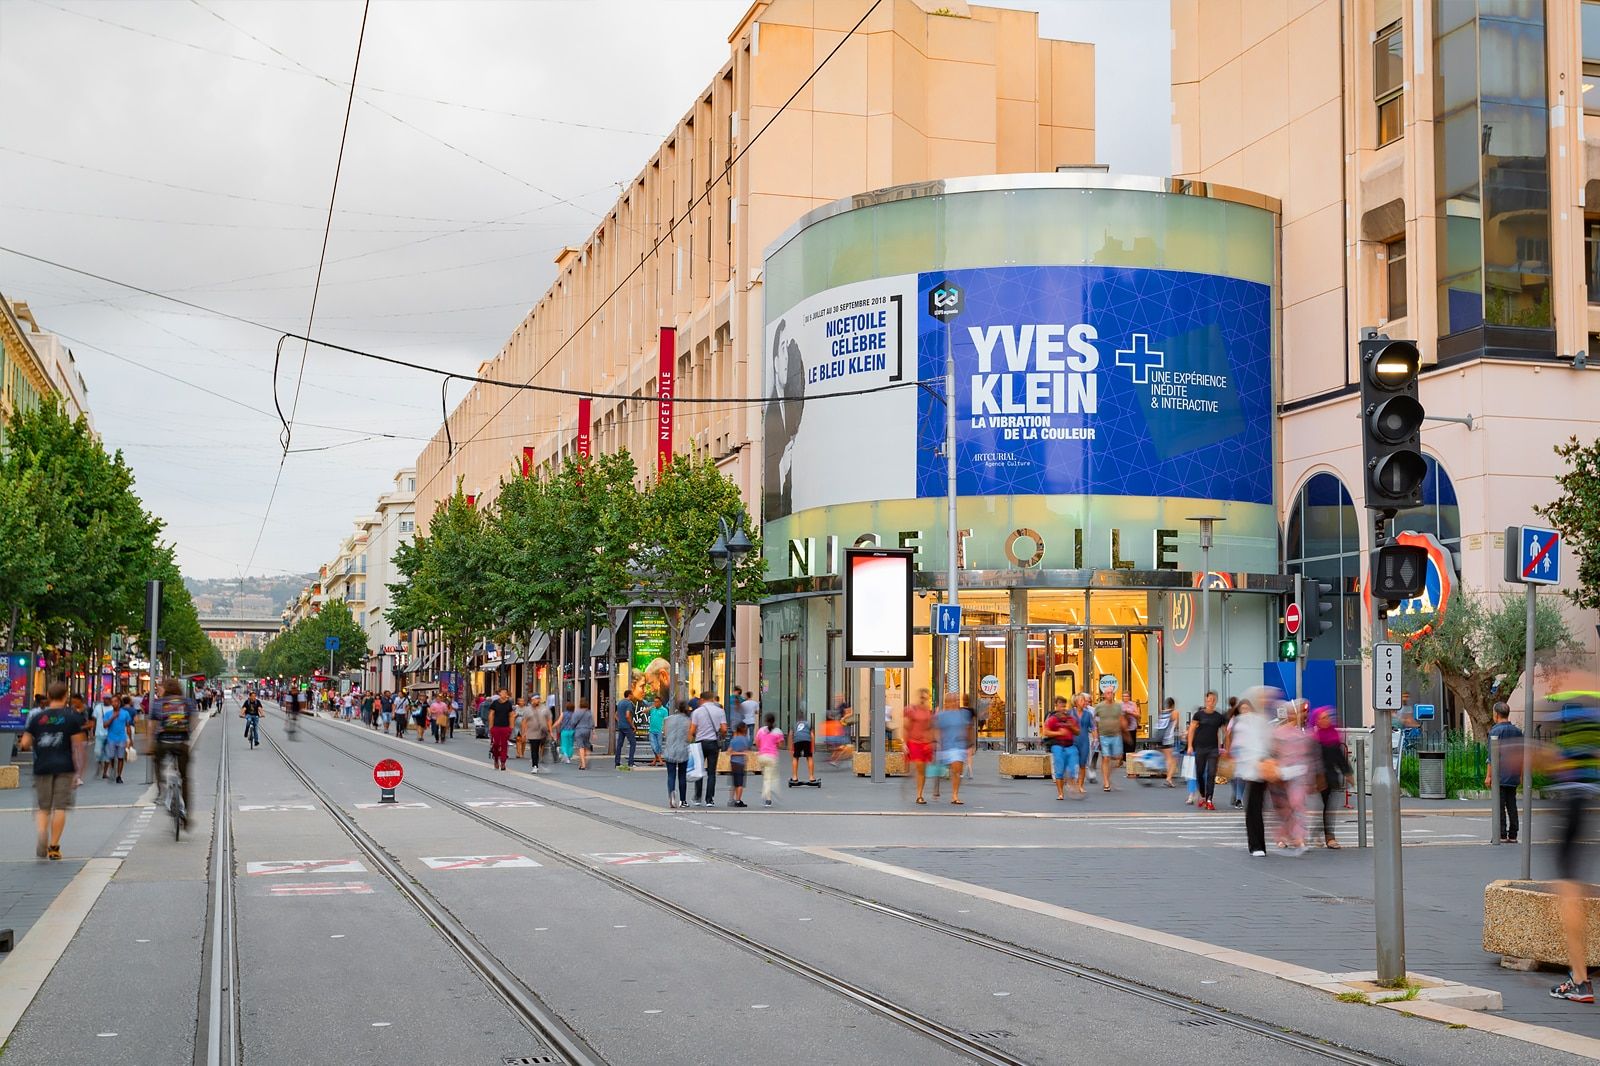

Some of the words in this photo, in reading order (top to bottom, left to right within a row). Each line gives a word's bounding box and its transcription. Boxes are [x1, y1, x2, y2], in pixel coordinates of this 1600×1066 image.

[812, 309, 826, 320] JUILLET
[826, 306, 832, 315] AU
[839, 299, 870, 311] SEPTEMBRE
[871, 296, 887, 305] 2018
[826, 311, 886, 338] NICETOILE
[832, 332, 886, 357] CÉLÈBRE
[968, 324, 1099, 373] YVES
[808, 367, 817, 384] LE
[820, 360, 845, 381] BLEU
[848, 353, 886, 374] KLEIN
[1151, 371, 1171, 384] UNE
[1174, 371, 1227, 388] EXPÉRIENCE
[1151, 382, 1187, 397] INÉDITE
[971, 373, 1097, 415] KLEIN
[661, 372, 670, 440] NICETOILE
[1151, 398, 1159, 408] &
[1161, 398, 1218, 413] INTERACTIVE
[971, 417, 986, 429] LA
[989, 416, 1050, 428] VIBRATION
[1004, 429, 1019, 440] DE
[1023, 428, 1038, 439] LA
[1041, 428, 1095, 439] COULEUR
[972, 453, 1017, 461] ARTCURIAL
[1079, 638, 1119, 646] bvenue
